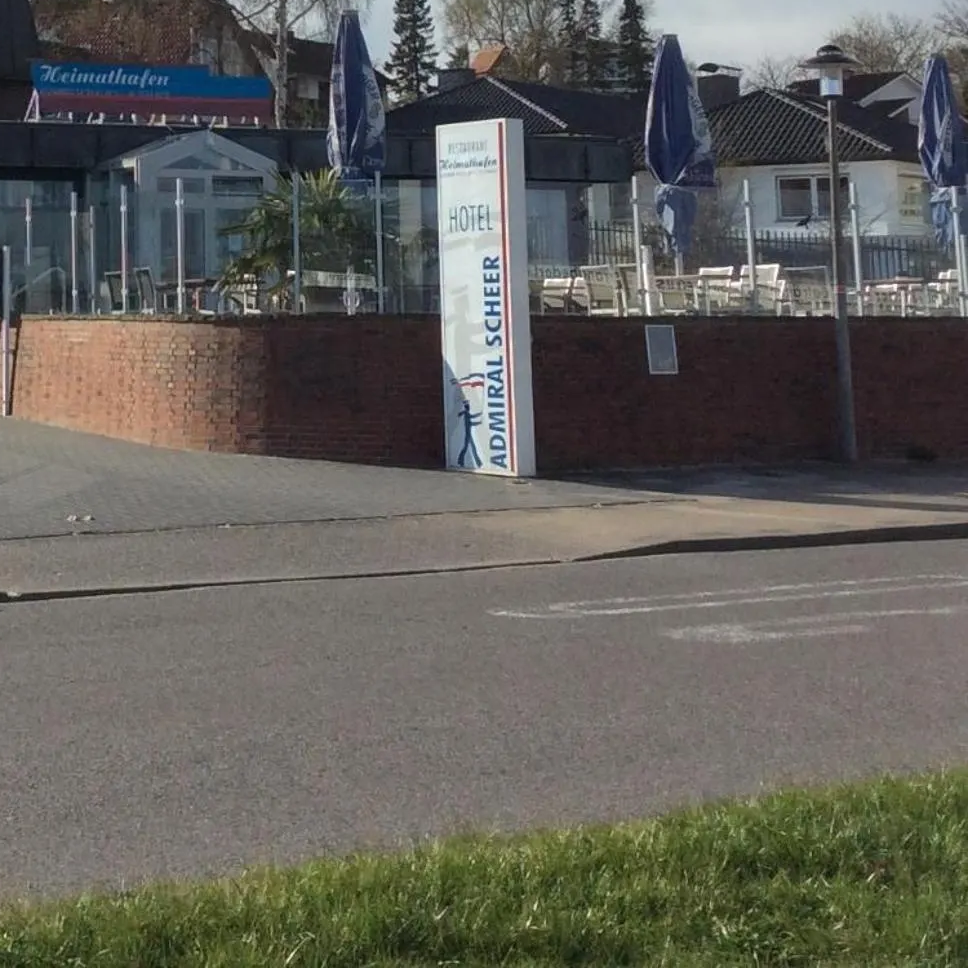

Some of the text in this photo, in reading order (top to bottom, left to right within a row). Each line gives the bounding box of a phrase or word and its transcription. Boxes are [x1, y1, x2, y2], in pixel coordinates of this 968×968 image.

[40, 64, 170, 88] Heimathafen
[439, 156, 498, 170] Heimathafen
[448, 204, 494, 233] HOTEL
[483, 254, 508, 469] ADMIRAL SCHEER
